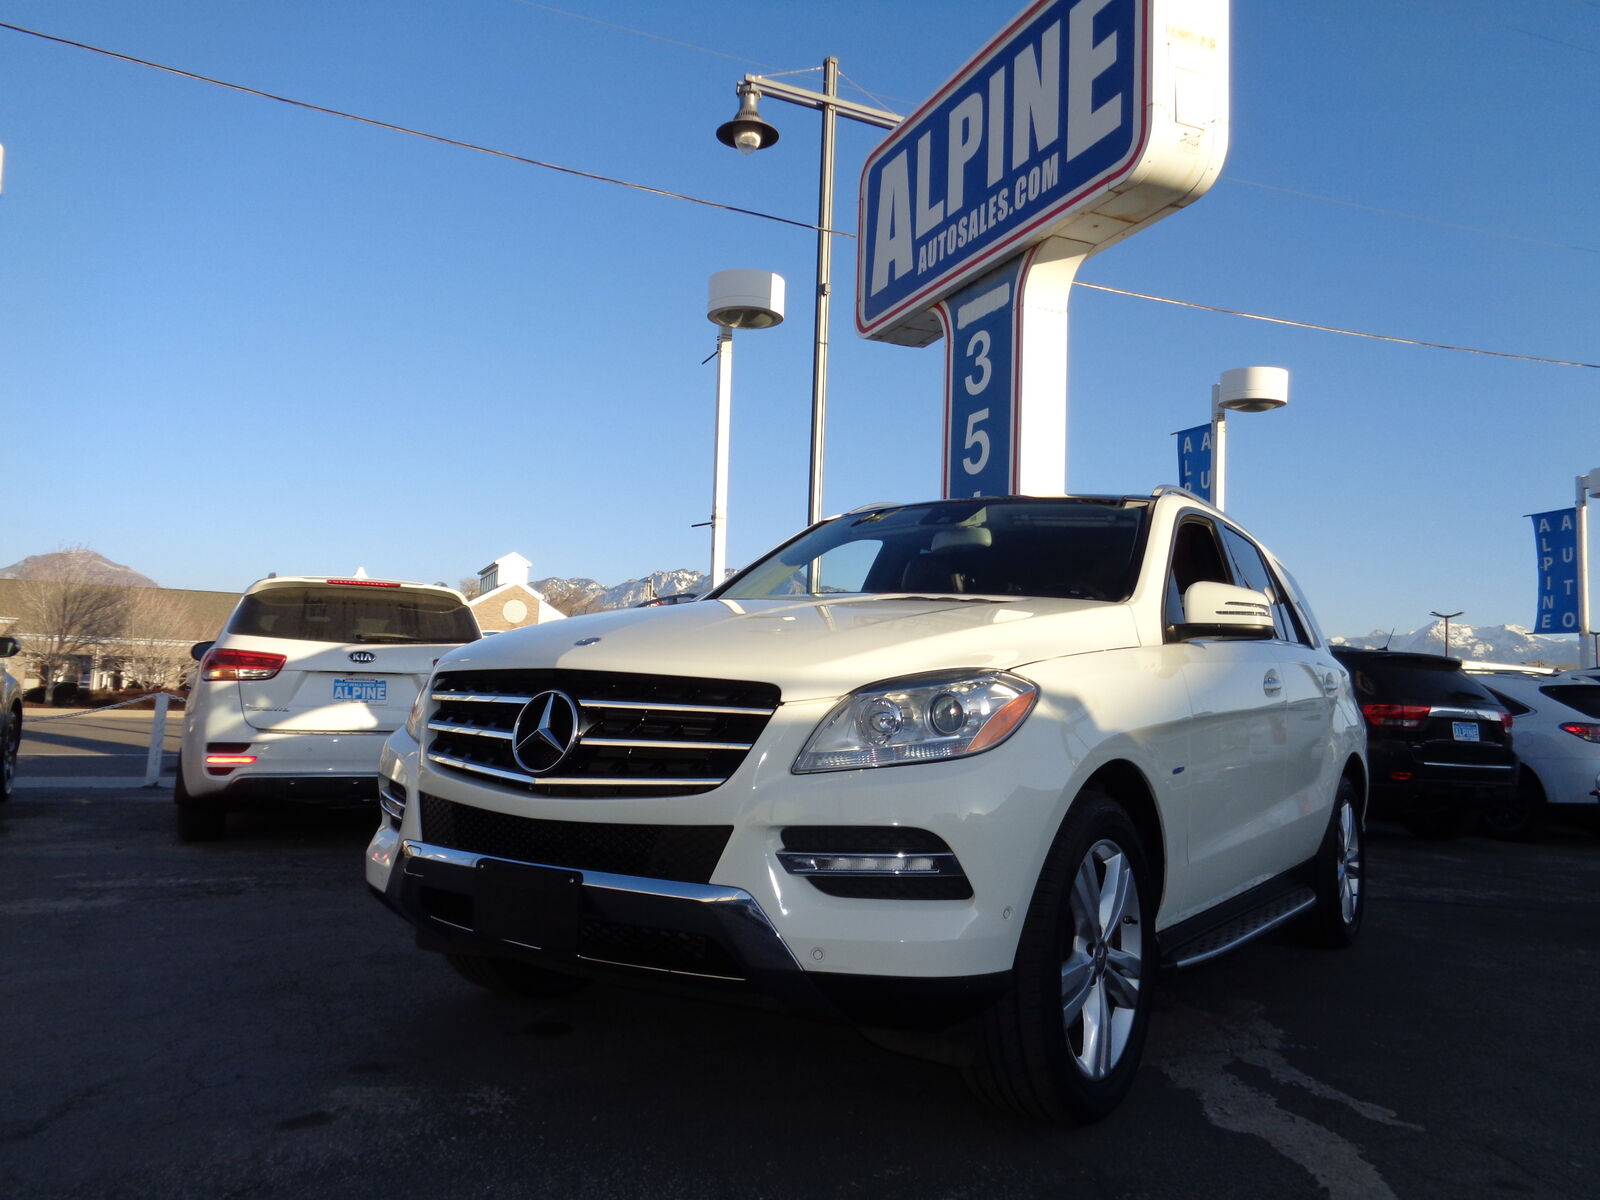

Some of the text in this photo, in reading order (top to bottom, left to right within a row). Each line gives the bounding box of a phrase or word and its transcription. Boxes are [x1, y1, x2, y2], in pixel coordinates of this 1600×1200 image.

[870, 0, 1122, 297] ALPINE
[916, 152, 1059, 276] AUTOSALES.COM
[962, 329, 993, 497] 35
[1538, 518, 1555, 629] ALPINE
[1561, 514, 1576, 628] AUTO
[334, 686, 387, 700] ALPINE
[352, 652, 373, 661] KIA
